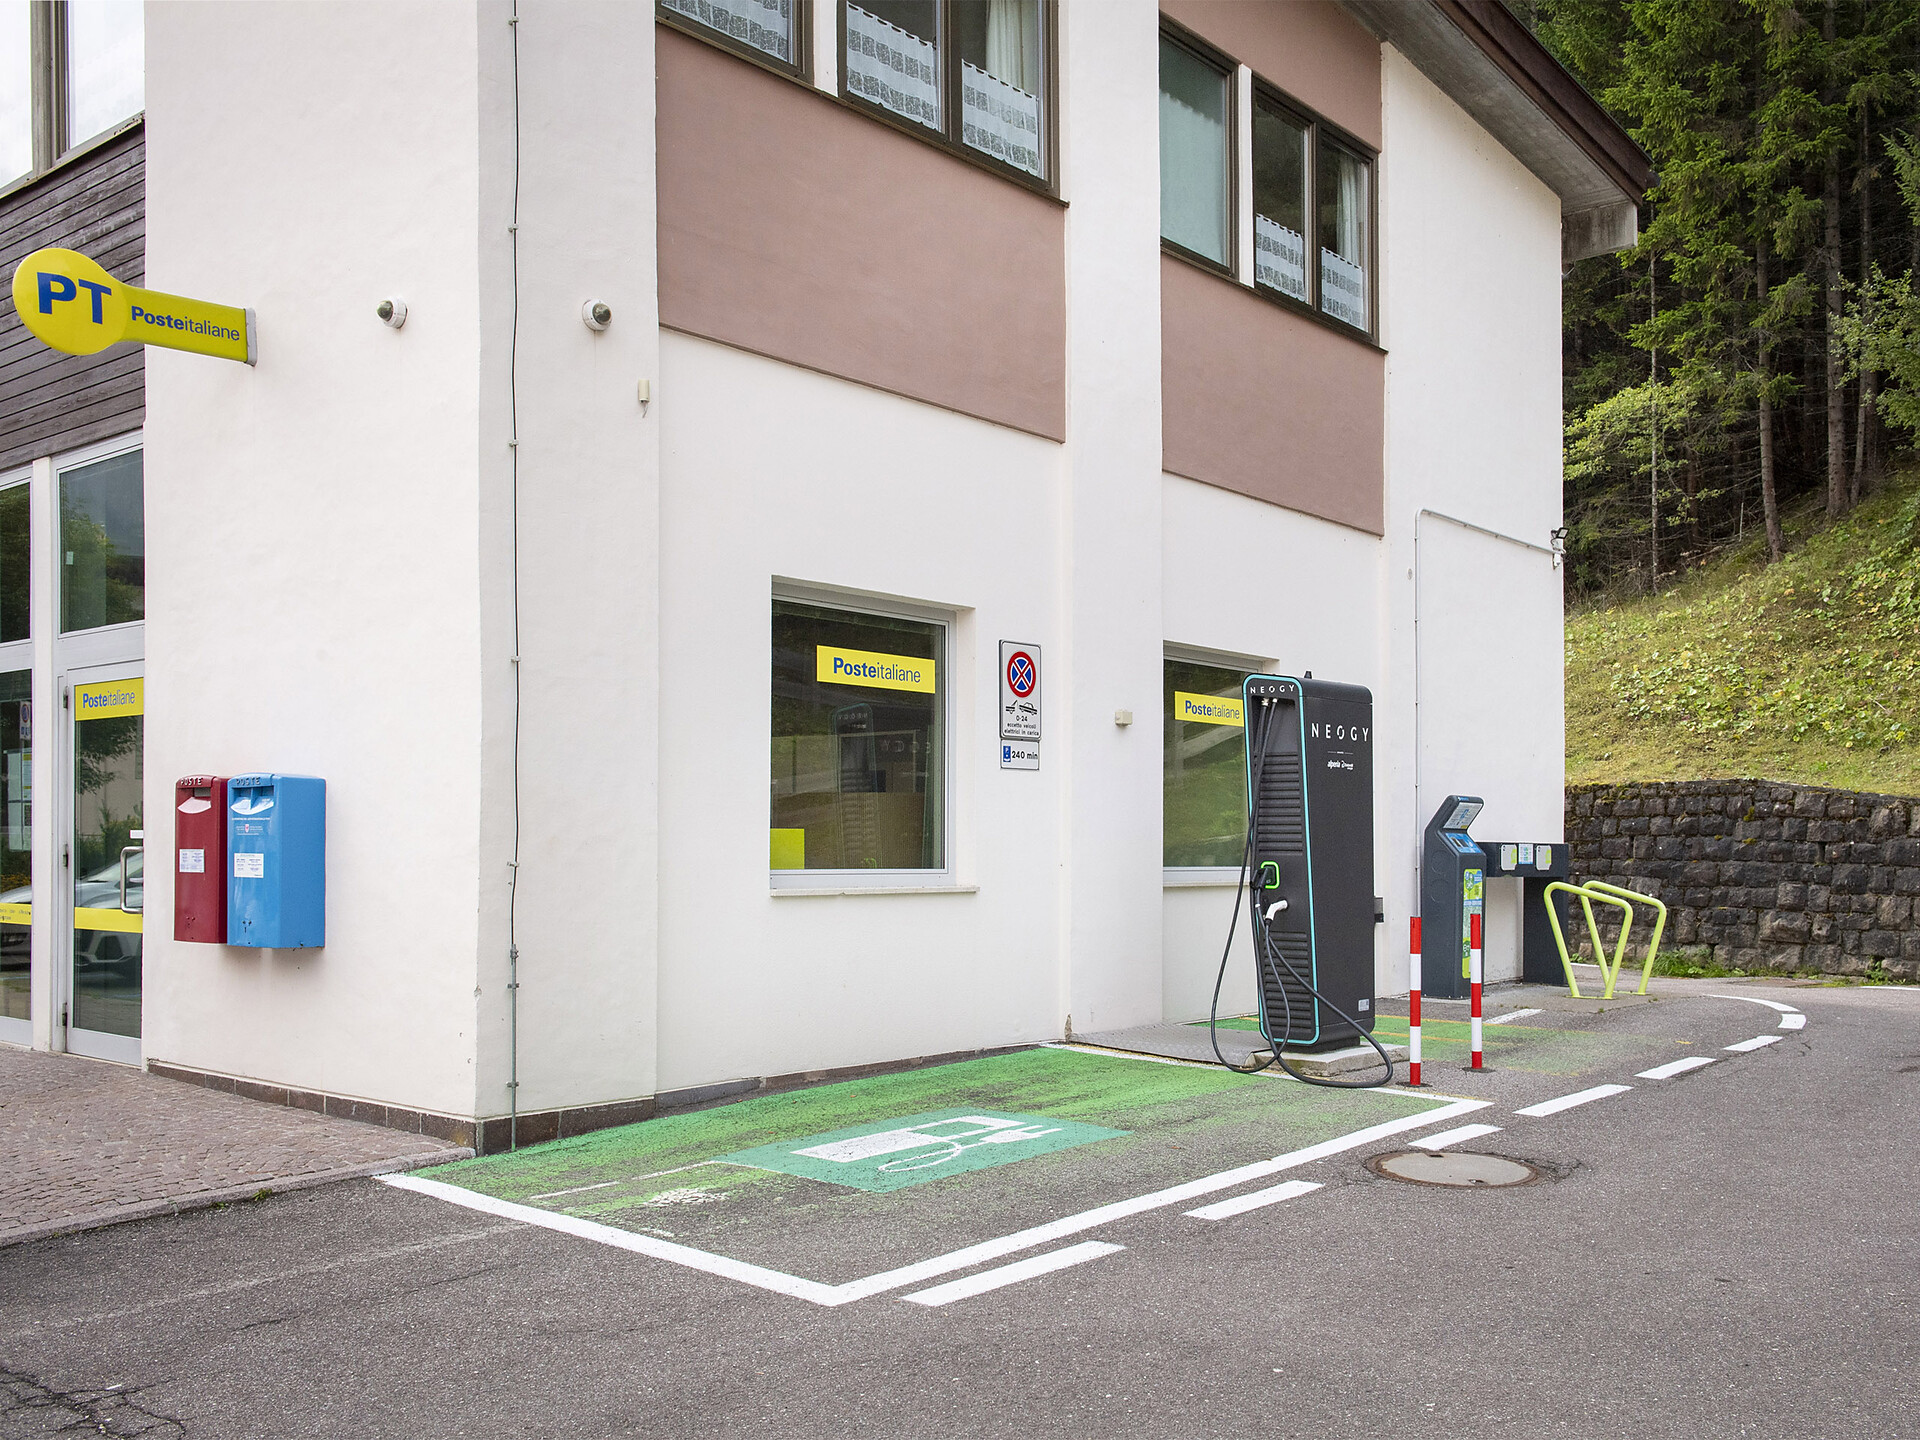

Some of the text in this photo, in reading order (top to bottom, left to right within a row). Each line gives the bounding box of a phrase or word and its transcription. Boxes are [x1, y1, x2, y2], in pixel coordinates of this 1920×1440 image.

[37, 272, 112, 325] PT
[131, 305, 240, 341] Posteitaliane
[833, 657, 921, 683] Posteitaliane
[83, 689, 135, 708] Posteitaliane
[1250, 684, 1295, 694] NEOGY
[1184, 700, 1240, 719] Posteitaliane
[1311, 723, 1369, 742] NEOGY
[1011, 751, 1038, 760] 240 min
[181, 777, 203, 786] POSTE
[236, 777, 261, 786] POSTE
